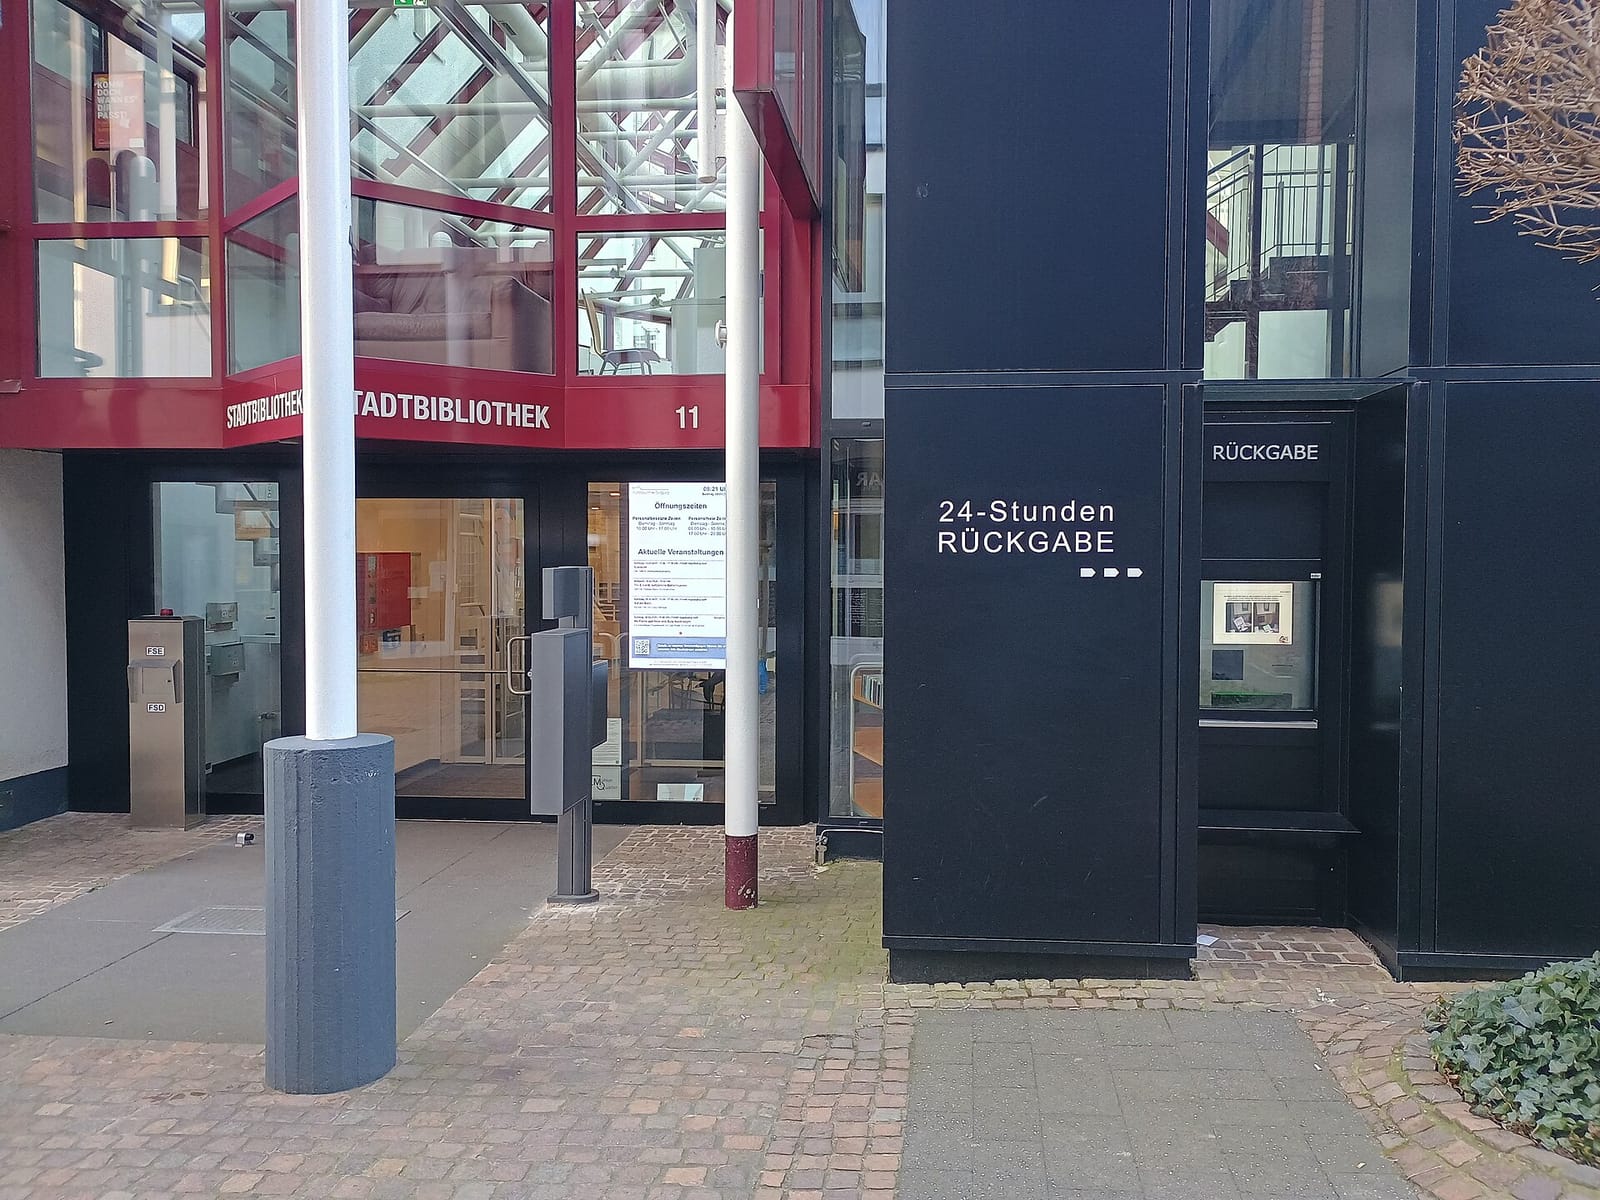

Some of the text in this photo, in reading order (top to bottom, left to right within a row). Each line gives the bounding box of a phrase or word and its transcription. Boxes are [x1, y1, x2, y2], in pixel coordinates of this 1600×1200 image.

[226, 389, 304, 429] STADTBIBLIOTHEK
[353, 389, 551, 429] TADTBIBLIOTHEK
[675, 405, 700, 430] 11
[1213, 441, 1319, 460] RÜCKGABE
[654, 501, 708, 511] Öffnungszeiten
[939, 500, 1114, 522] 24-Stunden
[938, 528, 1114, 553] RÜCKGABE
[667, 548, 724, 557] Veranstaltungen
[147, 647, 163, 655] FSE
